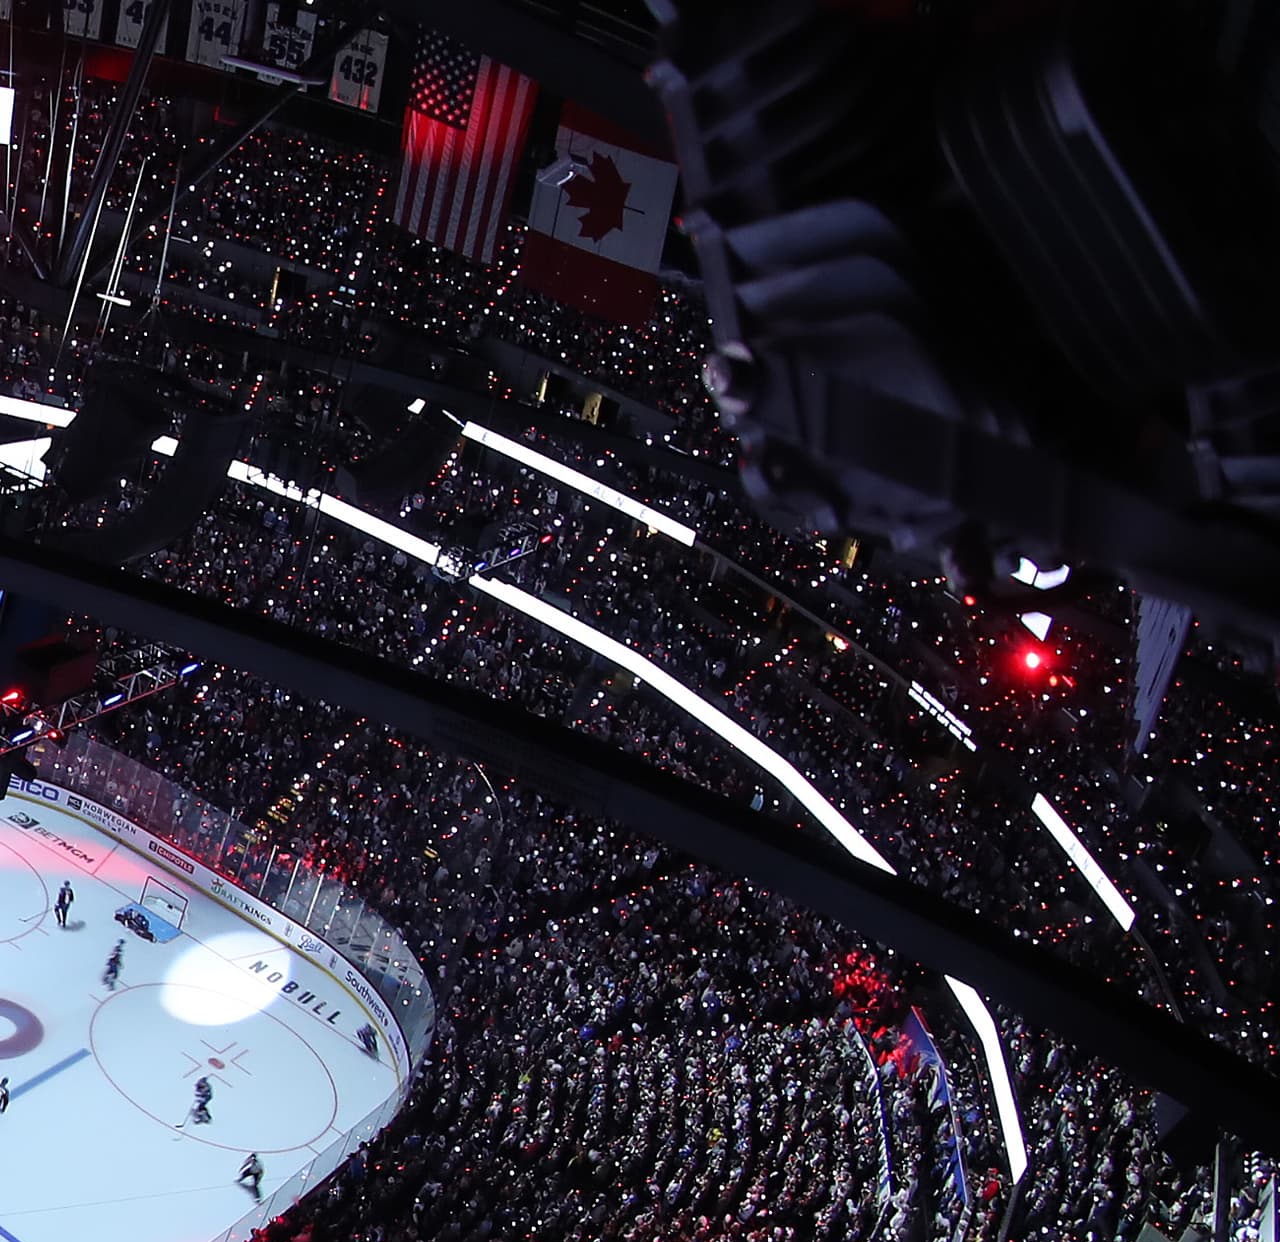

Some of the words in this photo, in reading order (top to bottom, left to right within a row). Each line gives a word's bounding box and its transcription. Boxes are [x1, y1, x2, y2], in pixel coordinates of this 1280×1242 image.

[198, 17, 233, 46] 44
[339, 55, 378, 87] 432
[8, 776, 60, 801] EICO
[83, 800, 137, 835] NORWEGIAN
[34, 826, 95, 864] BETMGM
[157, 844, 194, 874] CHIPOTLE
[211, 884, 272, 926] DRAFTKINGS
[298, 933, 324, 954] Ball
[248, 959, 342, 1026] NOBULL
[345, 969, 385, 1020] Southwest
